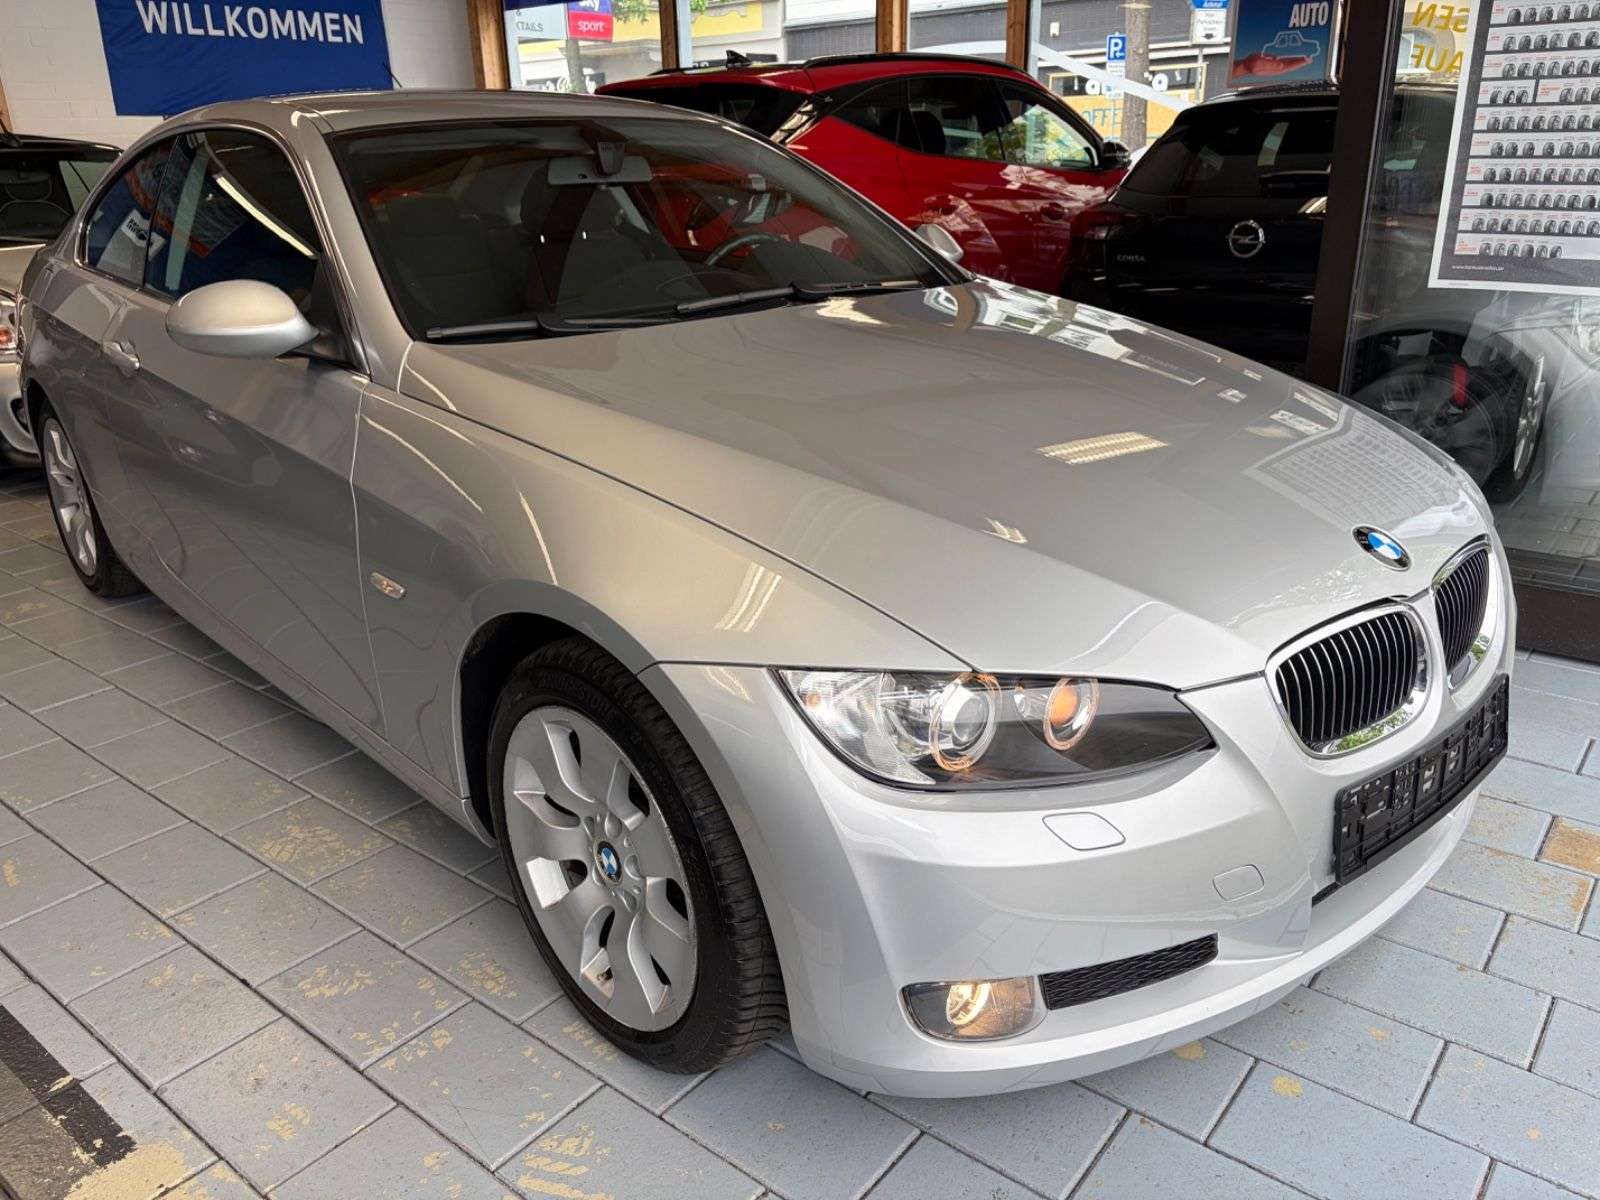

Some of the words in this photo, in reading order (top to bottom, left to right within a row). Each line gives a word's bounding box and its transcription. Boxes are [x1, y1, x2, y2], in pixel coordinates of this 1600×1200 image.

[135, 0, 364, 44] WILLKOMMEN
[577, 20, 604, 32] sport
[1289, 2, 1329, 28] AUTO
